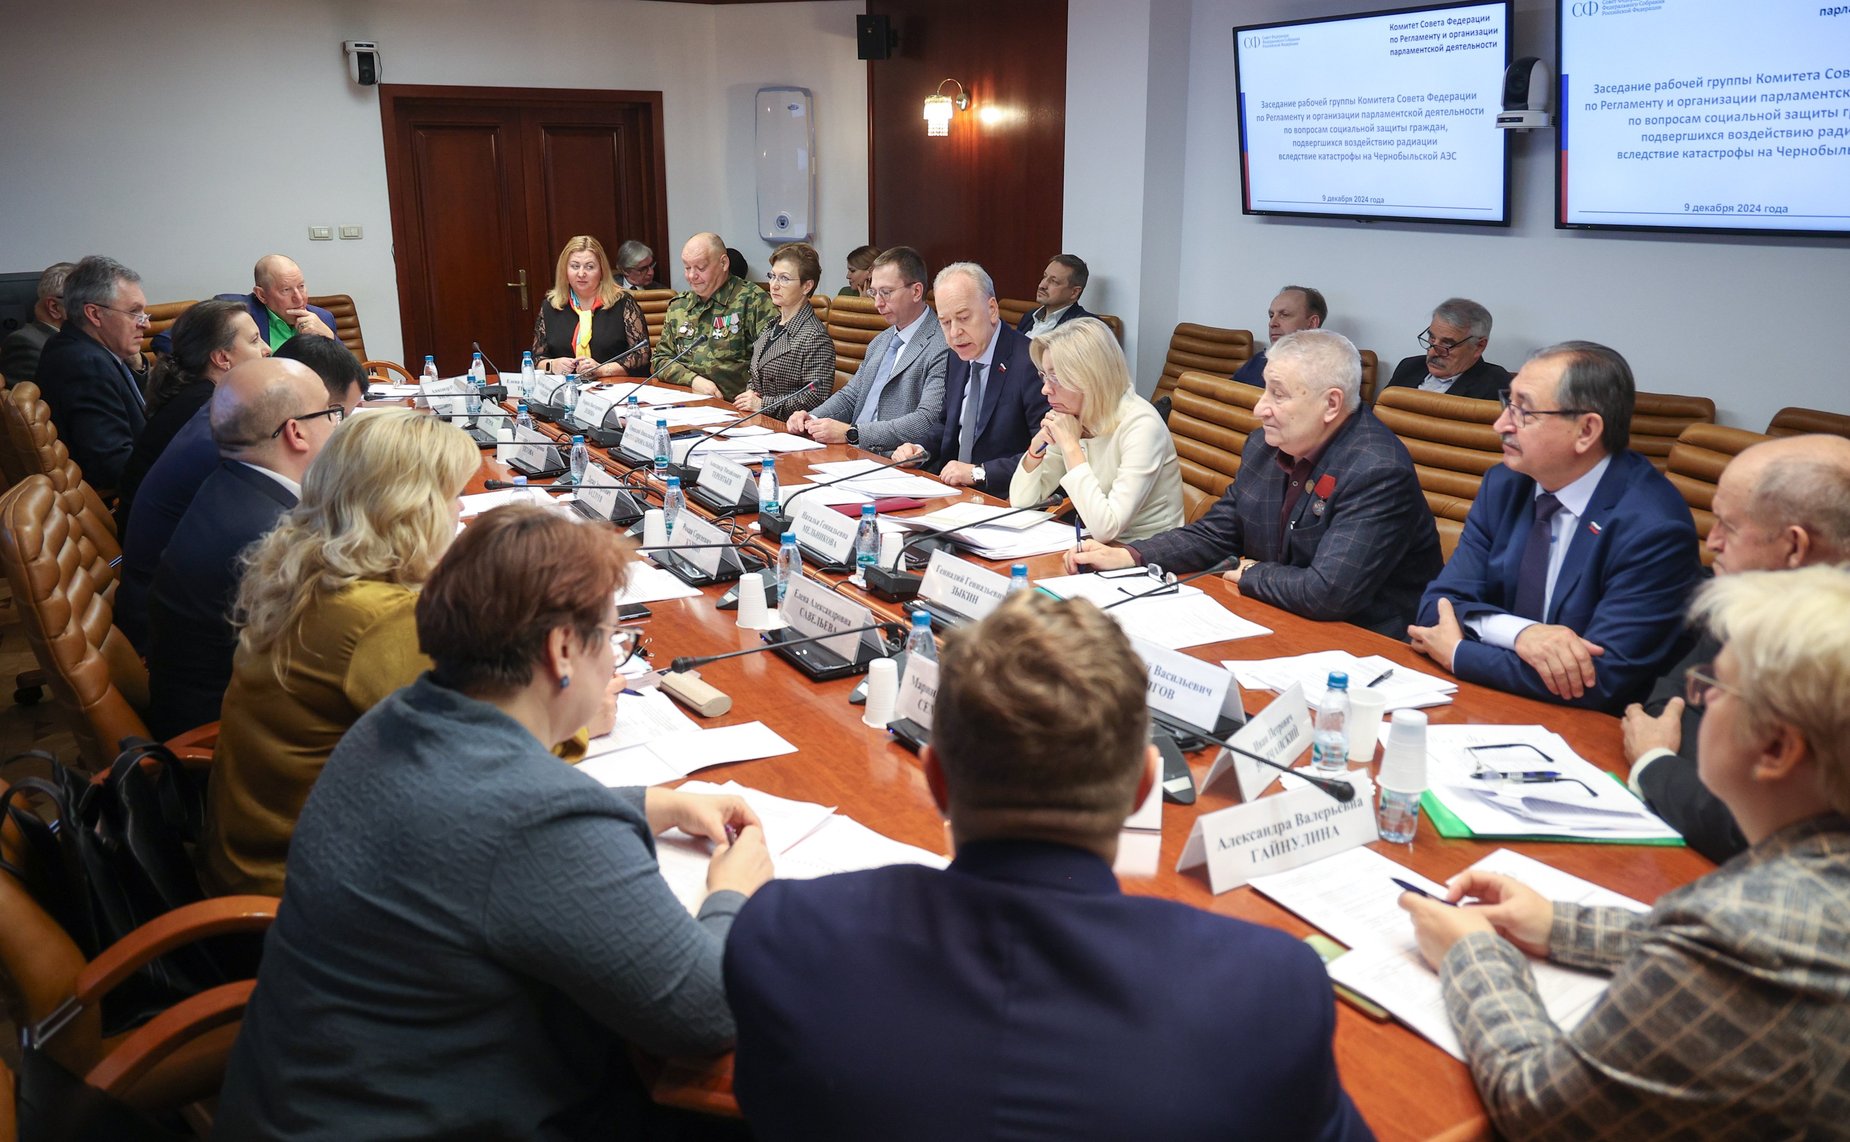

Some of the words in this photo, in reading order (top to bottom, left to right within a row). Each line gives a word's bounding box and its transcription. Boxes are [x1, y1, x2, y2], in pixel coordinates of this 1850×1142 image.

[1820, 6, 1850, 17] парл
[1389, 22, 1419, 31] Комитет
[1420, 20, 1445, 29] Совета
[1446, 15, 1490, 26] Федерации
[1400, 33, 1440, 43] Регламенту
[1448, 27, 1498, 39] организации
[1389, 44, 1444, 56] парламентской
[1445, 41, 1498, 52] деятельности
[1593, 82, 1652, 95] Заседание
[1654, 76, 1704, 93] рабочей
[1707, 76, 1752, 89] группы
[1756, 71, 1820, 84] Комитета
[1261, 100, 1297, 110] Заседание
[1297, 97, 1328, 109] рабочей
[1329, 98, 1356, 108] группы
[1357, 96, 1395, 105] Комитета
[1396, 94, 1425, 103] Совета
[1426, 92, 1477, 103] Федерации
[1584, 102, 1598, 111] по
[1600, 99, 1664, 111] Регламенту
[1666, 99, 1674, 108] и
[1677, 94, 1757, 109] организации
[1265, 113, 1305, 122] Регламенту
[1312, 111, 1360, 121] организации
[1361, 108, 1423, 119] парламентской
[1424, 107, 1485, 118] деятельности
[1628, 117, 1642, 126] по
[1644, 114, 1701, 127] вопросам
[1704, 108, 1781, 124] социальной
[1784, 108, 1839, 121] защиты
[1293, 126, 1328, 135] вопросам
[1329, 123, 1375, 134] социальной
[1376, 124, 1408, 134] защиты
[1409, 123, 1449, 133] граждан,
[1641, 130, 1724, 143] подвергшихся
[1727, 127, 1814, 141] воздействию
[1292, 139, 1343, 148] подвергшихся
[1344, 137, 1395, 148] воздействию
[1396, 138, 1438, 148] радиации
[1278, 153, 1317, 161] вследствие
[1318, 152, 1362, 162] катастрофы
[1362, 153, 1372, 161] на
[1373, 151, 1438, 162] Чернобыльской
[1440, 152, 1457, 161] АЭС
[1617, 150, 1680, 161] вследствие
[1682, 147, 1754, 160] катастрофы
[1757, 149, 1773, 157] на
[1327, 194, 1353, 203] декабря
[1354, 195, 1369, 203] 2024
[1684, 203, 1690, 211] 9
[1692, 203, 1734, 214] декабря
[1737, 204, 1761, 213] 2024
[1764, 205, 1789, 214] года
[802, 524, 837, 549] МЕЛЬНИКОВА
[936, 564, 965, 583] Геннадий
[951, 585, 979, 605] ЗЫКИН
[793, 588, 810, 604] Елена
[811, 598, 852, 627] Александровна
[799, 607, 837, 633] САВЕЛЬЕВА
[1154, 664, 1213, 697] Васильевич
[1217, 819, 1293, 851] Александра
[1294, 797, 1364, 828] Валерьевна
[1250, 825, 1341, 864] ГАЙНУЛИНА
